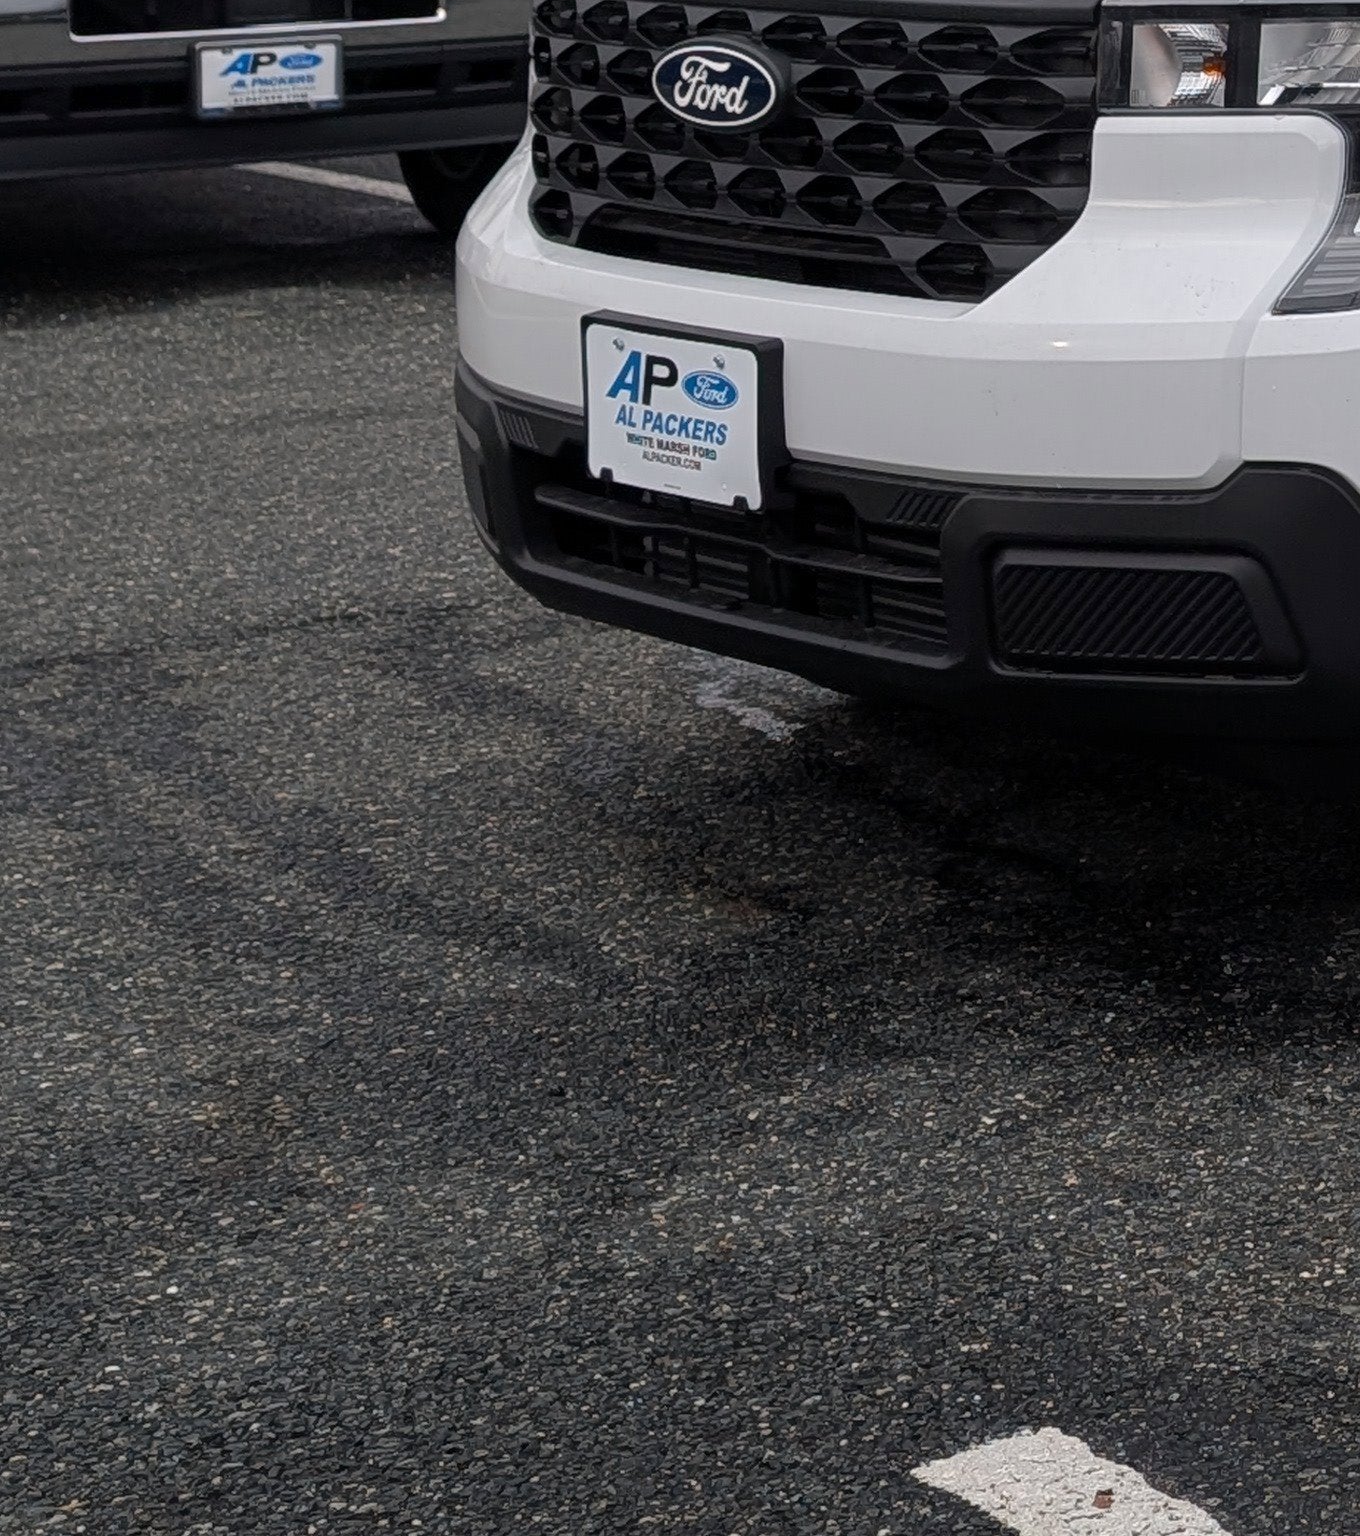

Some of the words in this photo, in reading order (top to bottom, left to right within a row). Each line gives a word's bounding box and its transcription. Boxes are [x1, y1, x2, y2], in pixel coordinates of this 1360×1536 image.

[219, 52, 277, 76] AP
[673, 55, 751, 115] Ford
[606, 350, 678, 406] AP
[615, 404, 637, 428] AL
[641, 409, 728, 446] PACKERS
[626, 432, 654, 449] WHITE
